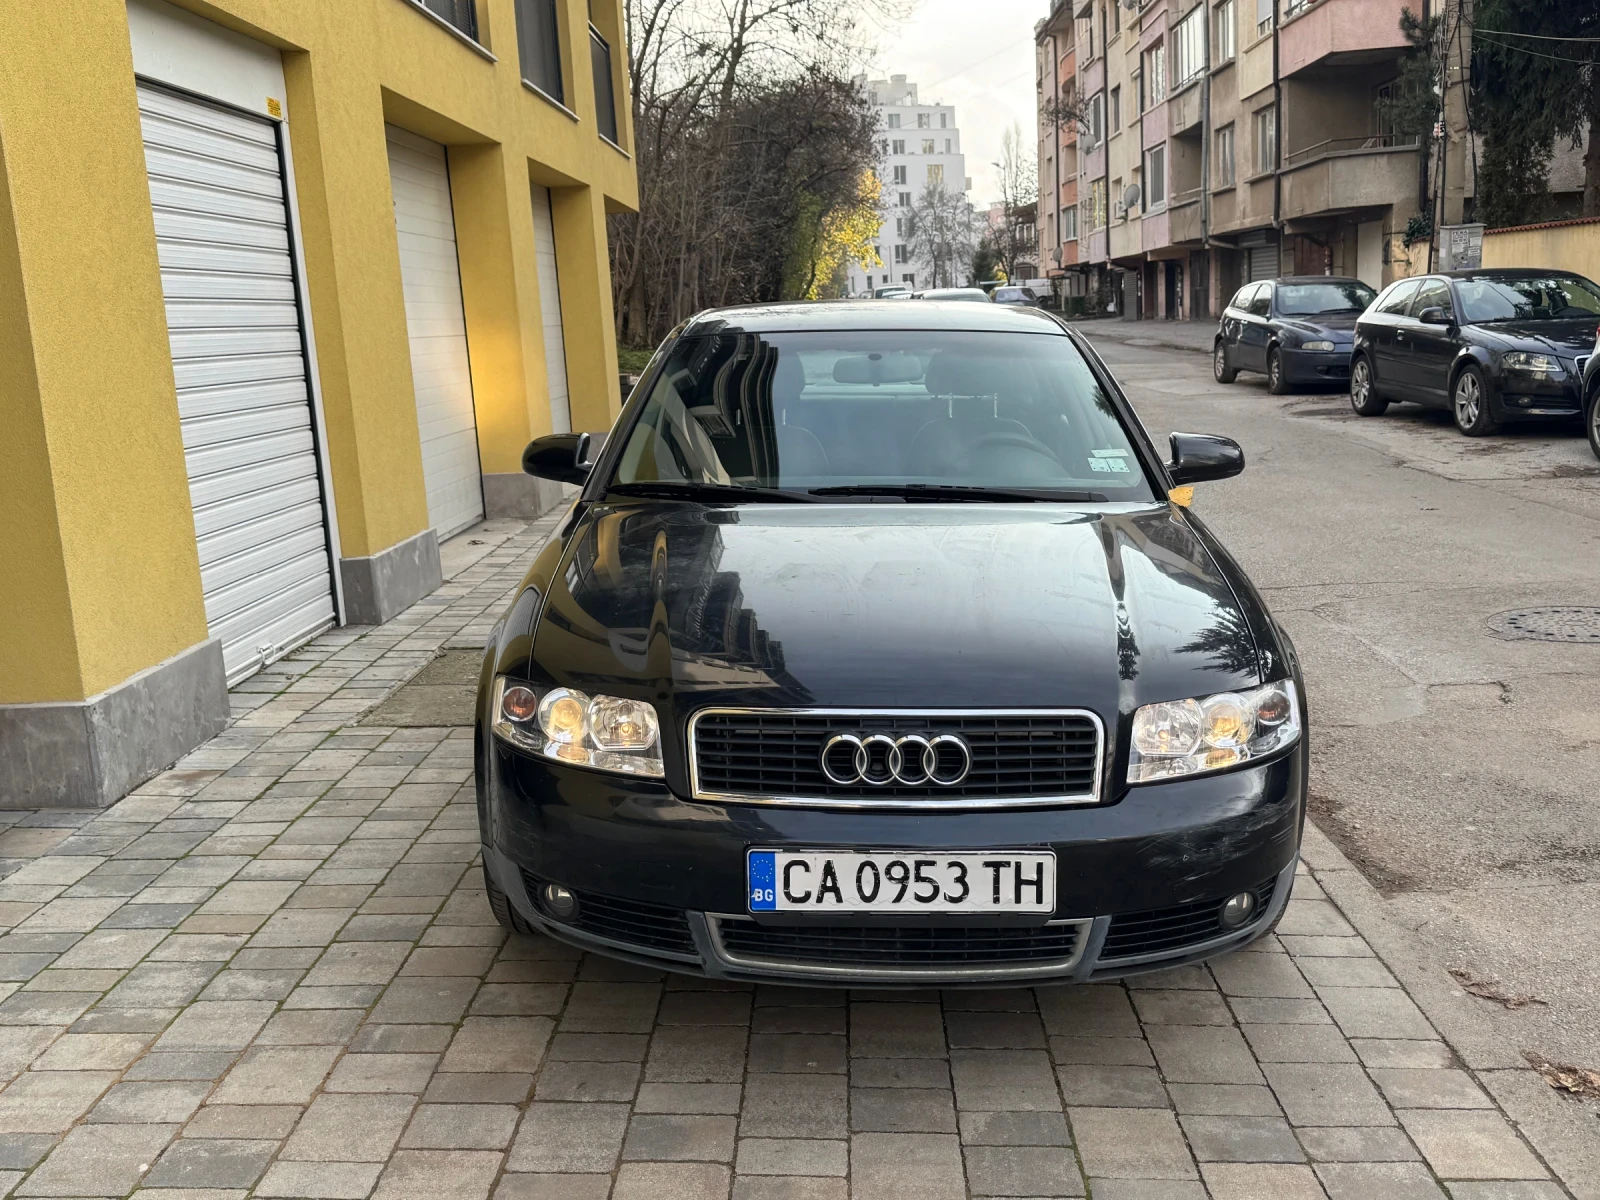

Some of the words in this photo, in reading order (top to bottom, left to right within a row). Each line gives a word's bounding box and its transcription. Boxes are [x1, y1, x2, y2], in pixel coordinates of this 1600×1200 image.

[754, 888, 774, 902] BG
[783, 859, 843, 904] CA
[855, 860, 970, 904] 0953
[982, 860, 1044, 905] TH
